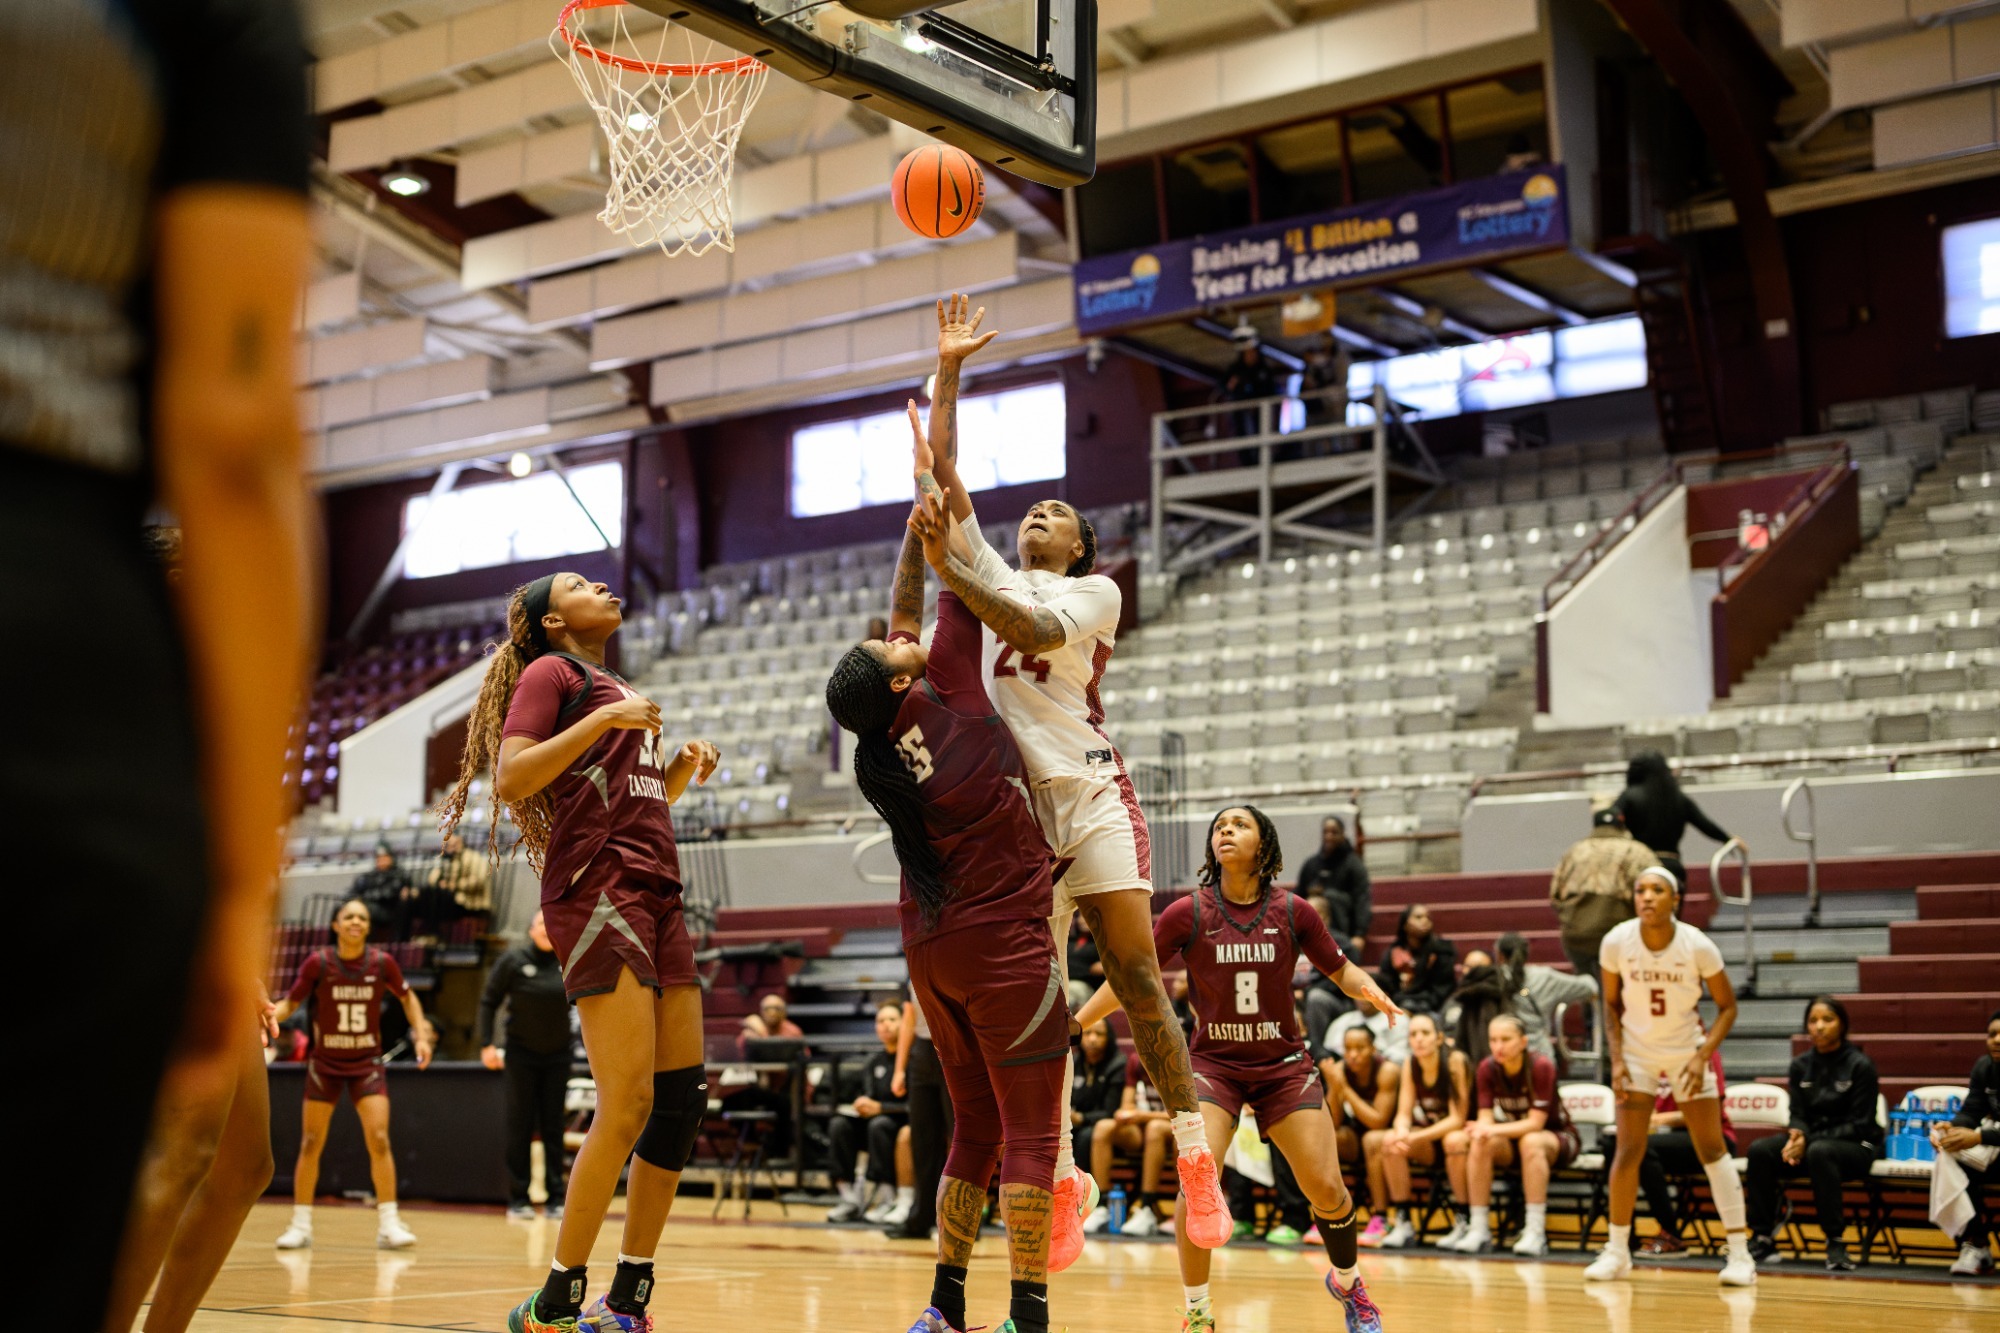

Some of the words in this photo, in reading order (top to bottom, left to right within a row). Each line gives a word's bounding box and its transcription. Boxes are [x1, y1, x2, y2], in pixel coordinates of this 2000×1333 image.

[1192, 239, 1280, 274] Raising
[1312, 217, 1394, 251] Billion
[1398, 211, 1418, 234] a
[1459, 209, 1551, 243] Lottery
[1191, 272, 1247, 301] Year
[1251, 264, 1288, 291] for
[1293, 240, 1421, 282] Education
[1081, 285, 1157, 318] Lottery
[895, 722, 934, 784] 5
[1216, 943, 1275, 963] MARYLAND
[1235, 971, 1260, 1015] 8
[1650, 988, 1667, 1017] 5
[337, 1002, 368, 1033] 15
[1208, 1022, 1253, 1042] EASTERN
[1256, 1021, 1282, 1040] SHOE
[1563, 1096, 1604, 1109] CCU
